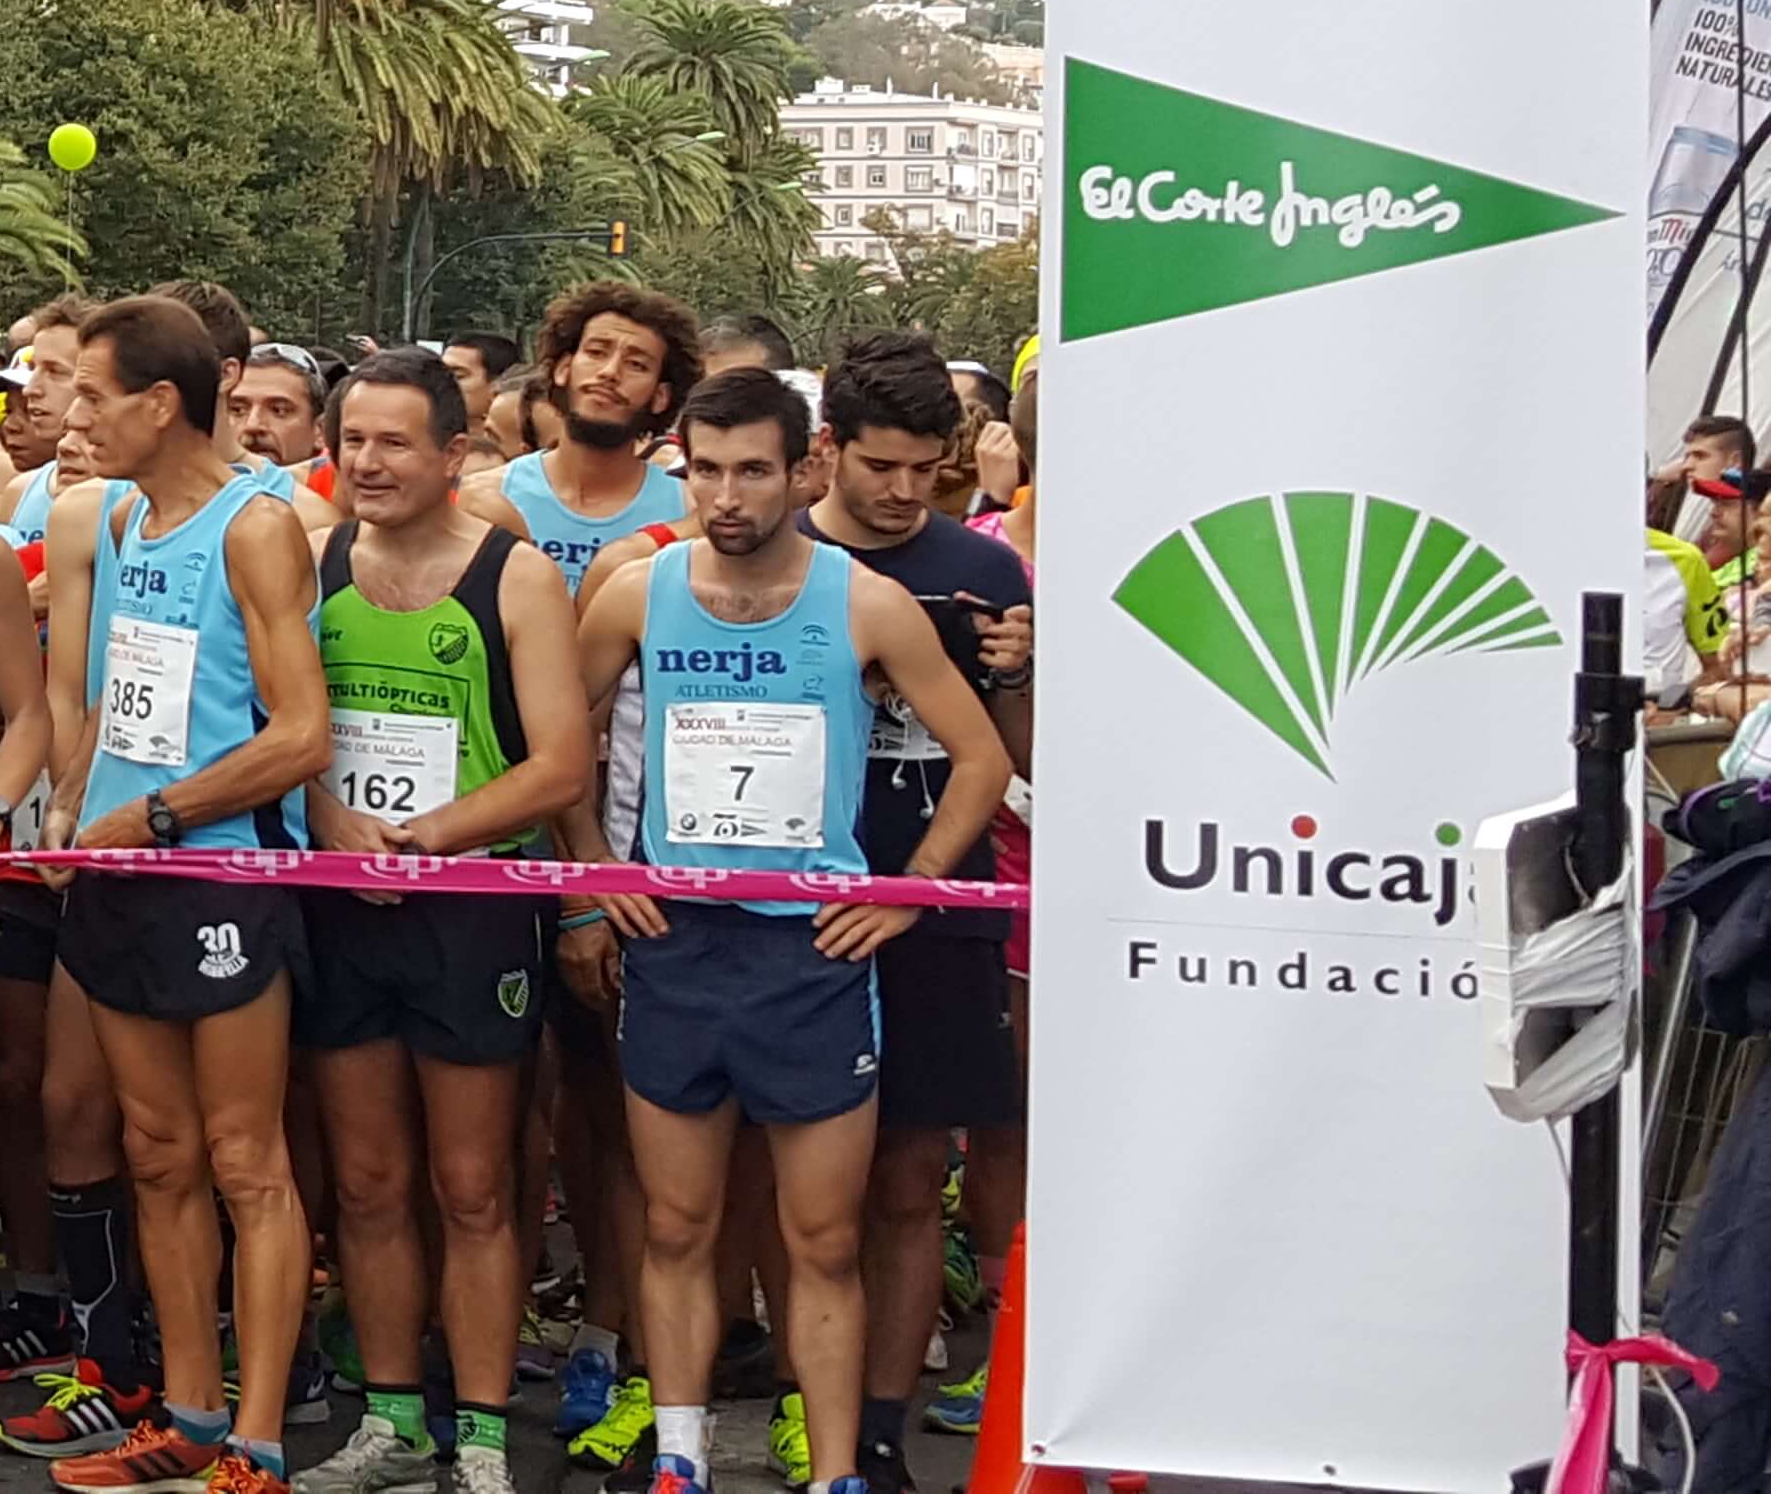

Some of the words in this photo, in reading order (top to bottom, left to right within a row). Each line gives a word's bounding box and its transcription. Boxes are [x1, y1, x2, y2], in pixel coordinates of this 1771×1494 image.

[1079, 166, 1134, 220] El
[1137, 172, 1264, 227] Corte
[1270, 161, 1460, 247] Inglés
[120, 560, 168, 598] erja
[657, 642, 787, 683] nerja
[110, 678, 154, 720] 385
[675, 684, 768, 698] ATLETISMO
[341, 771, 416, 812] 162
[730, 765, 755, 802] 7
[1144, 815, 1477, 926] Unicaj
[197, 922, 241, 954] 30
[1128, 941, 1478, 1000] Fundació
